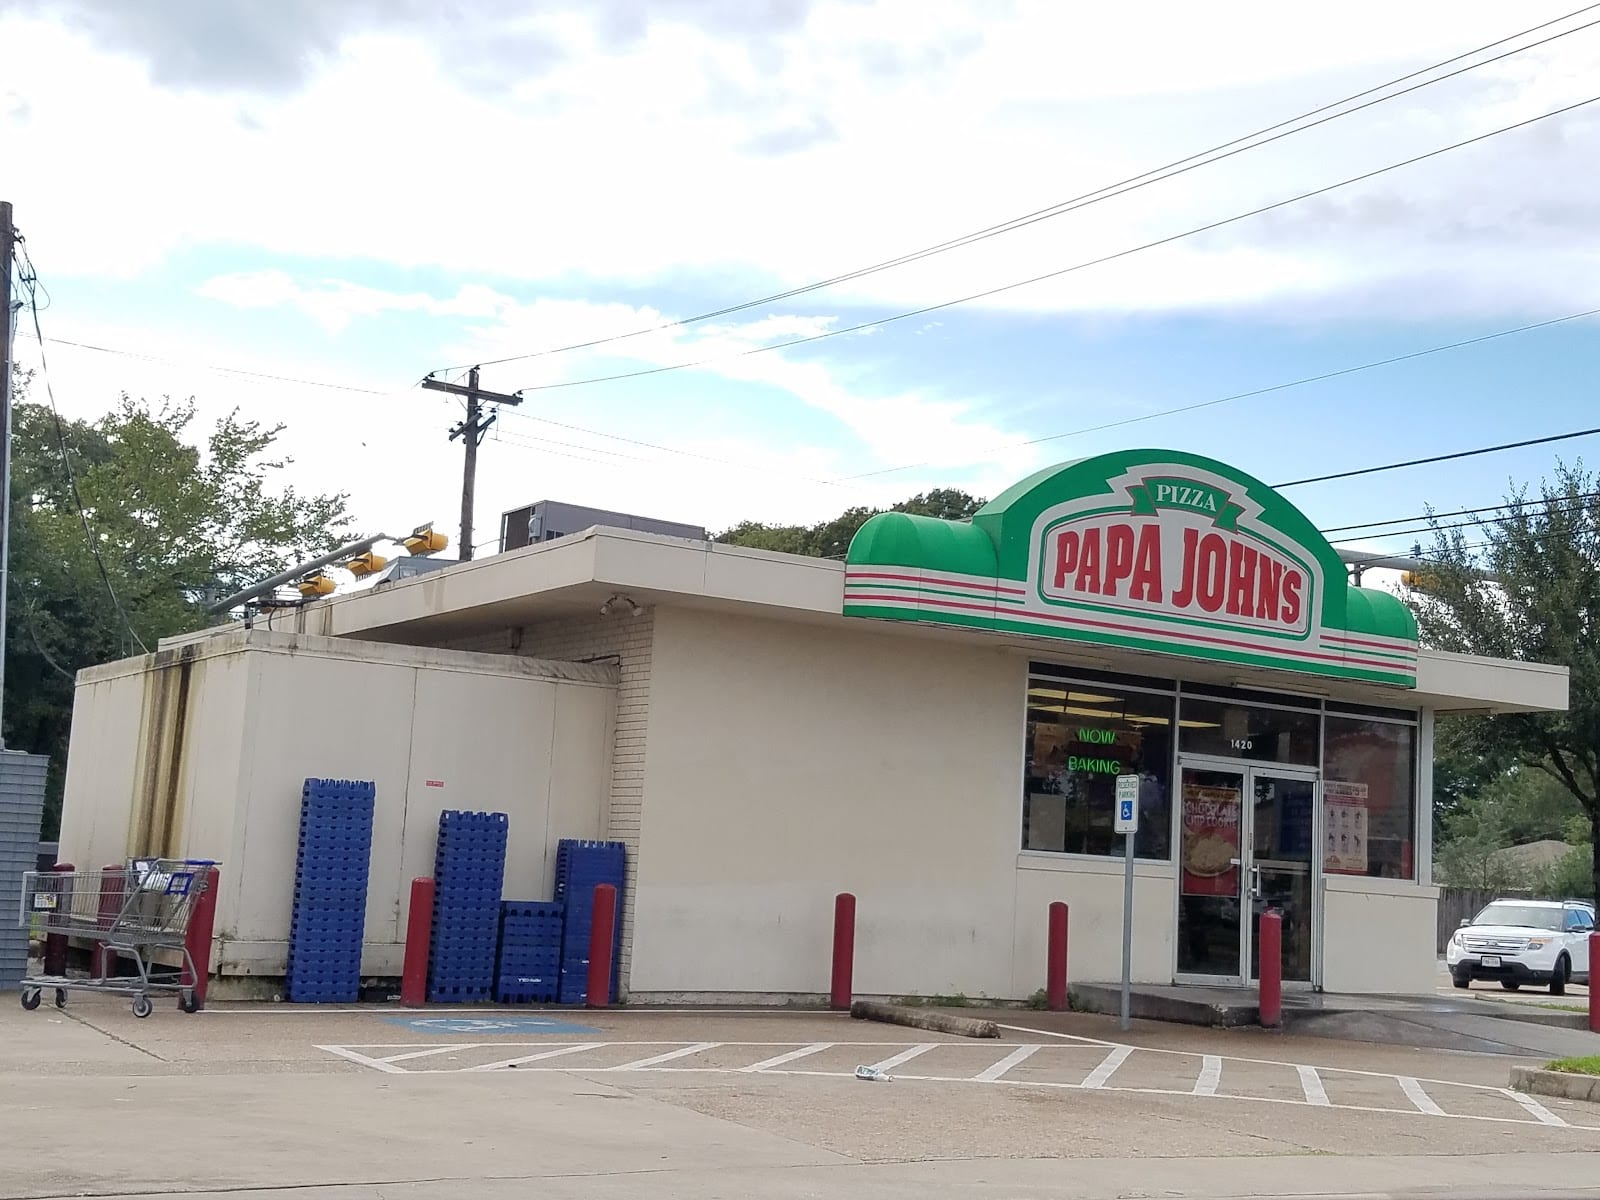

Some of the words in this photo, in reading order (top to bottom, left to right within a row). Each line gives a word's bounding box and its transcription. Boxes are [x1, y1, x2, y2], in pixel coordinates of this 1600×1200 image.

[1156, 484, 1217, 512] PIZZA
[1054, 524, 1163, 604] PAPA
[1172, 528, 1302, 625] JOHN'S
[1079, 728, 1115, 745] NOW
[1231, 739, 1252, 750] 1420
[1068, 755, 1121, 775] BAKING
